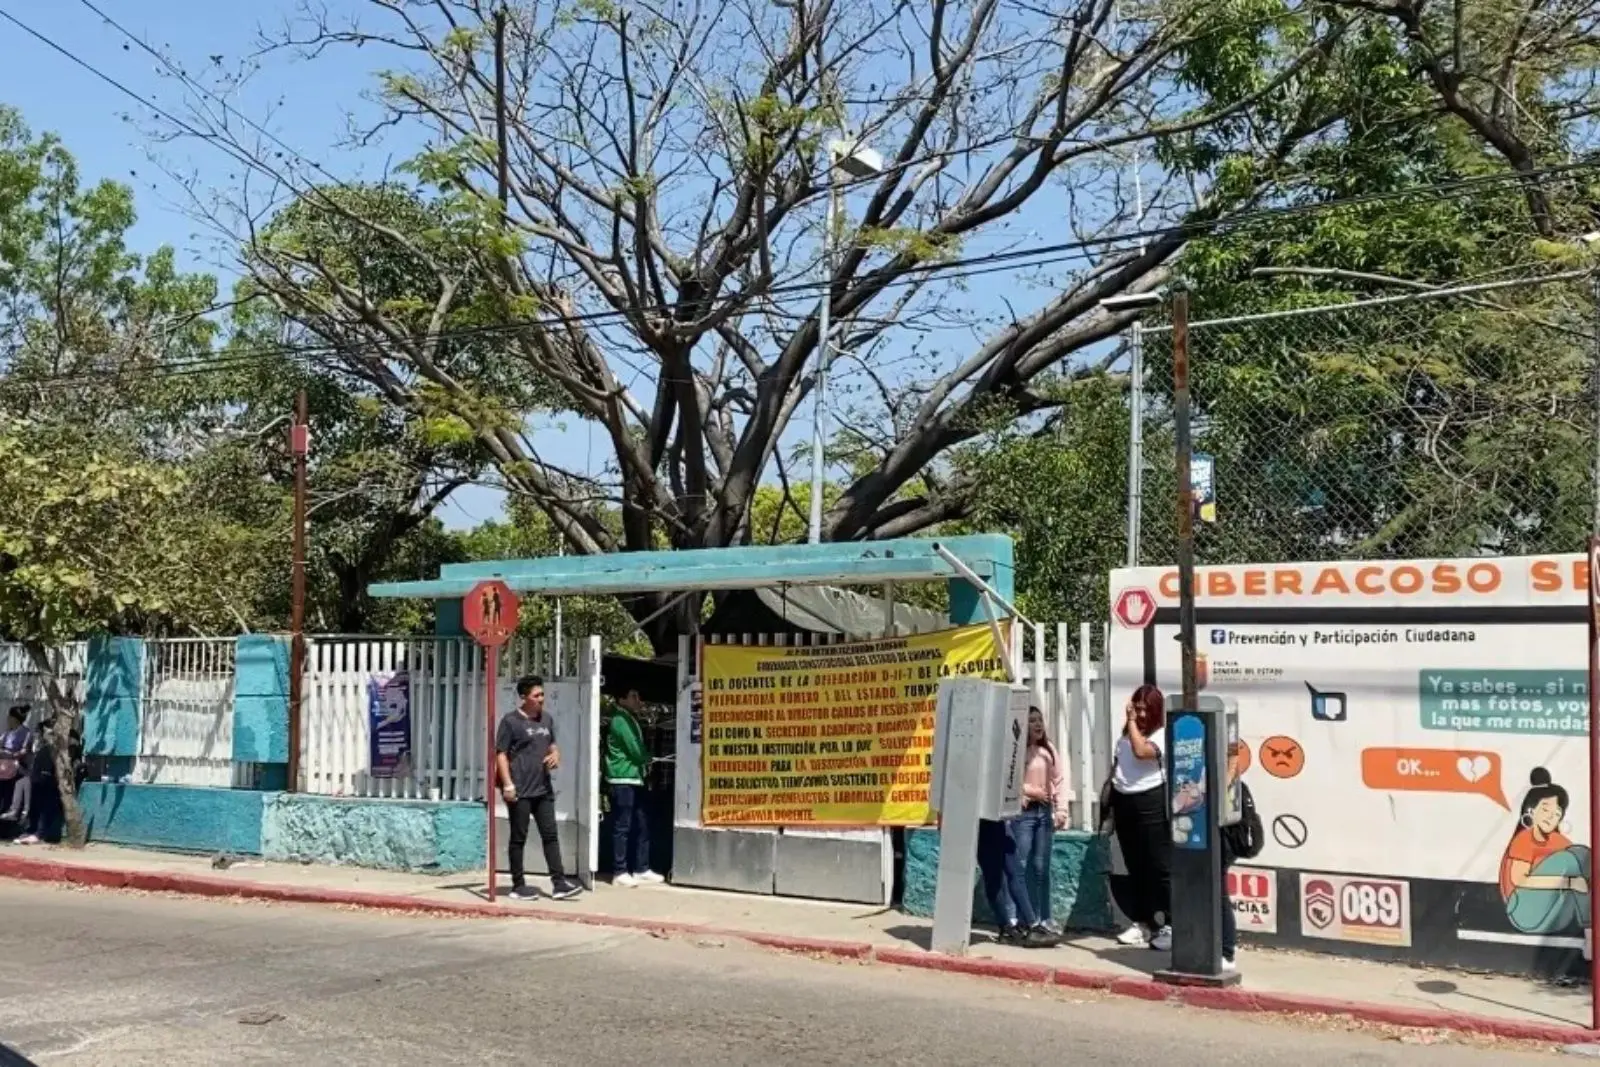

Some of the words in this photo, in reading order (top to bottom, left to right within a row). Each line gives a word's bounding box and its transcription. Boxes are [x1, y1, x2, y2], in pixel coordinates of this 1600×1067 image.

[1158, 562, 1501, 598] CIBERACOSO
[1228, 630, 1295, 645] Prevención
[1299, 634, 1308, 646] y
[1314, 629, 1397, 646] Participación
[1405, 629, 1476, 642] Ciudadana
[708, 678, 724, 690] LOS
[729, 676, 776, 689] DOCENTES
[780, 675, 793, 688] DE
[797, 675, 809, 687] LA
[918, 666, 931, 679] DE
[937, 664, 950, 677] LA
[955, 657, 1003, 674] ESCUELA
[1428, 676, 1453, 693] Ya
[1459, 677, 1517, 694] sabes
[1546, 678, 1564, 694] si
[834, 689, 851, 701] DEL
[787, 708, 829, 721] DIRECTOR
[831, 706, 866, 719] CARLOS
[867, 705, 879, 717] DE
[1442, 697, 1481, 711] mas
[1488, 695, 1553, 716] fotos,
[1432, 711, 1447, 727] la
[1451, 715, 1481, 731] que
[1487, 716, 1513, 728] me
[725, 727, 751, 740] COMO
[753, 726, 762, 738] AL
[766, 724, 818, 738] SECRETARIO
[709, 744, 719, 757] DE
[722, 743, 760, 756] NUESTRA
[842, 741, 853, 753] LO
[857, 740, 873, 753] QUE
[771, 759, 792, 772] PARA
[735, 776, 779, 789] SOLICITUD
[830, 773, 878, 787] SUSTENTO
[879, 773, 889, 785] EL
[1342, 884, 1400, 926] 089
